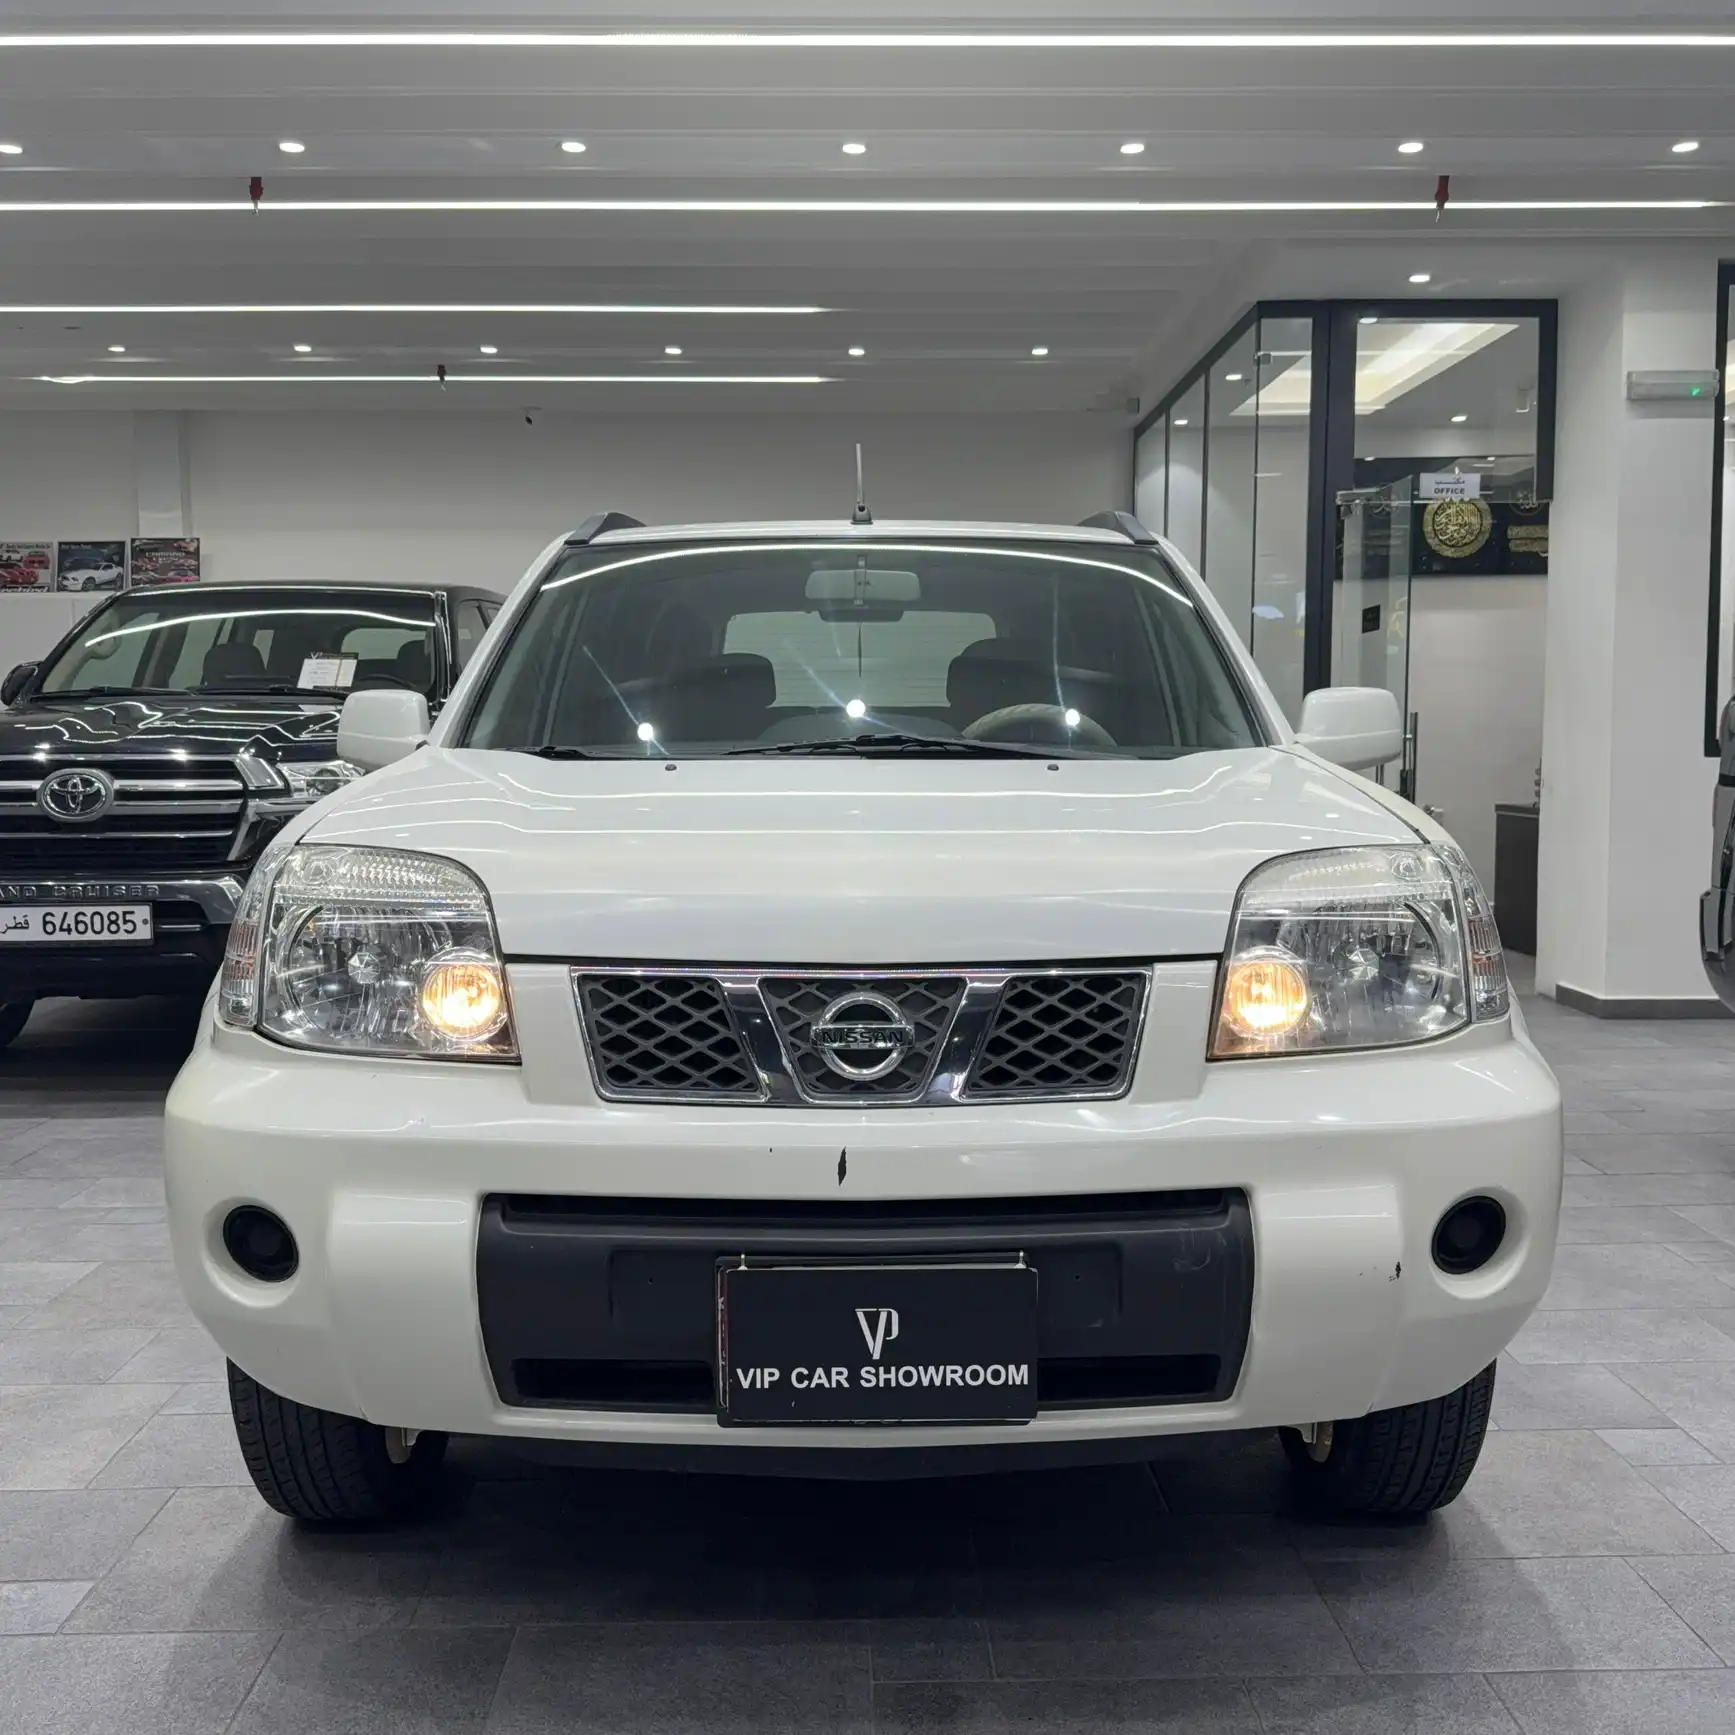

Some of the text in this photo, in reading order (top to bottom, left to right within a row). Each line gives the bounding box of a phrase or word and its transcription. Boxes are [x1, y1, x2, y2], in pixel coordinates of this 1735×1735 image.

[1434, 487, 1465, 495] OFFICE
[52, 885, 160, 898] CRUISER
[0, 914, 30, 935] قطر
[42, 911, 137, 936] 646085
[822, 1030, 904, 1043] NISSAN
[736, 1364, 1029, 1389] VIP CAR SHOWROOM
